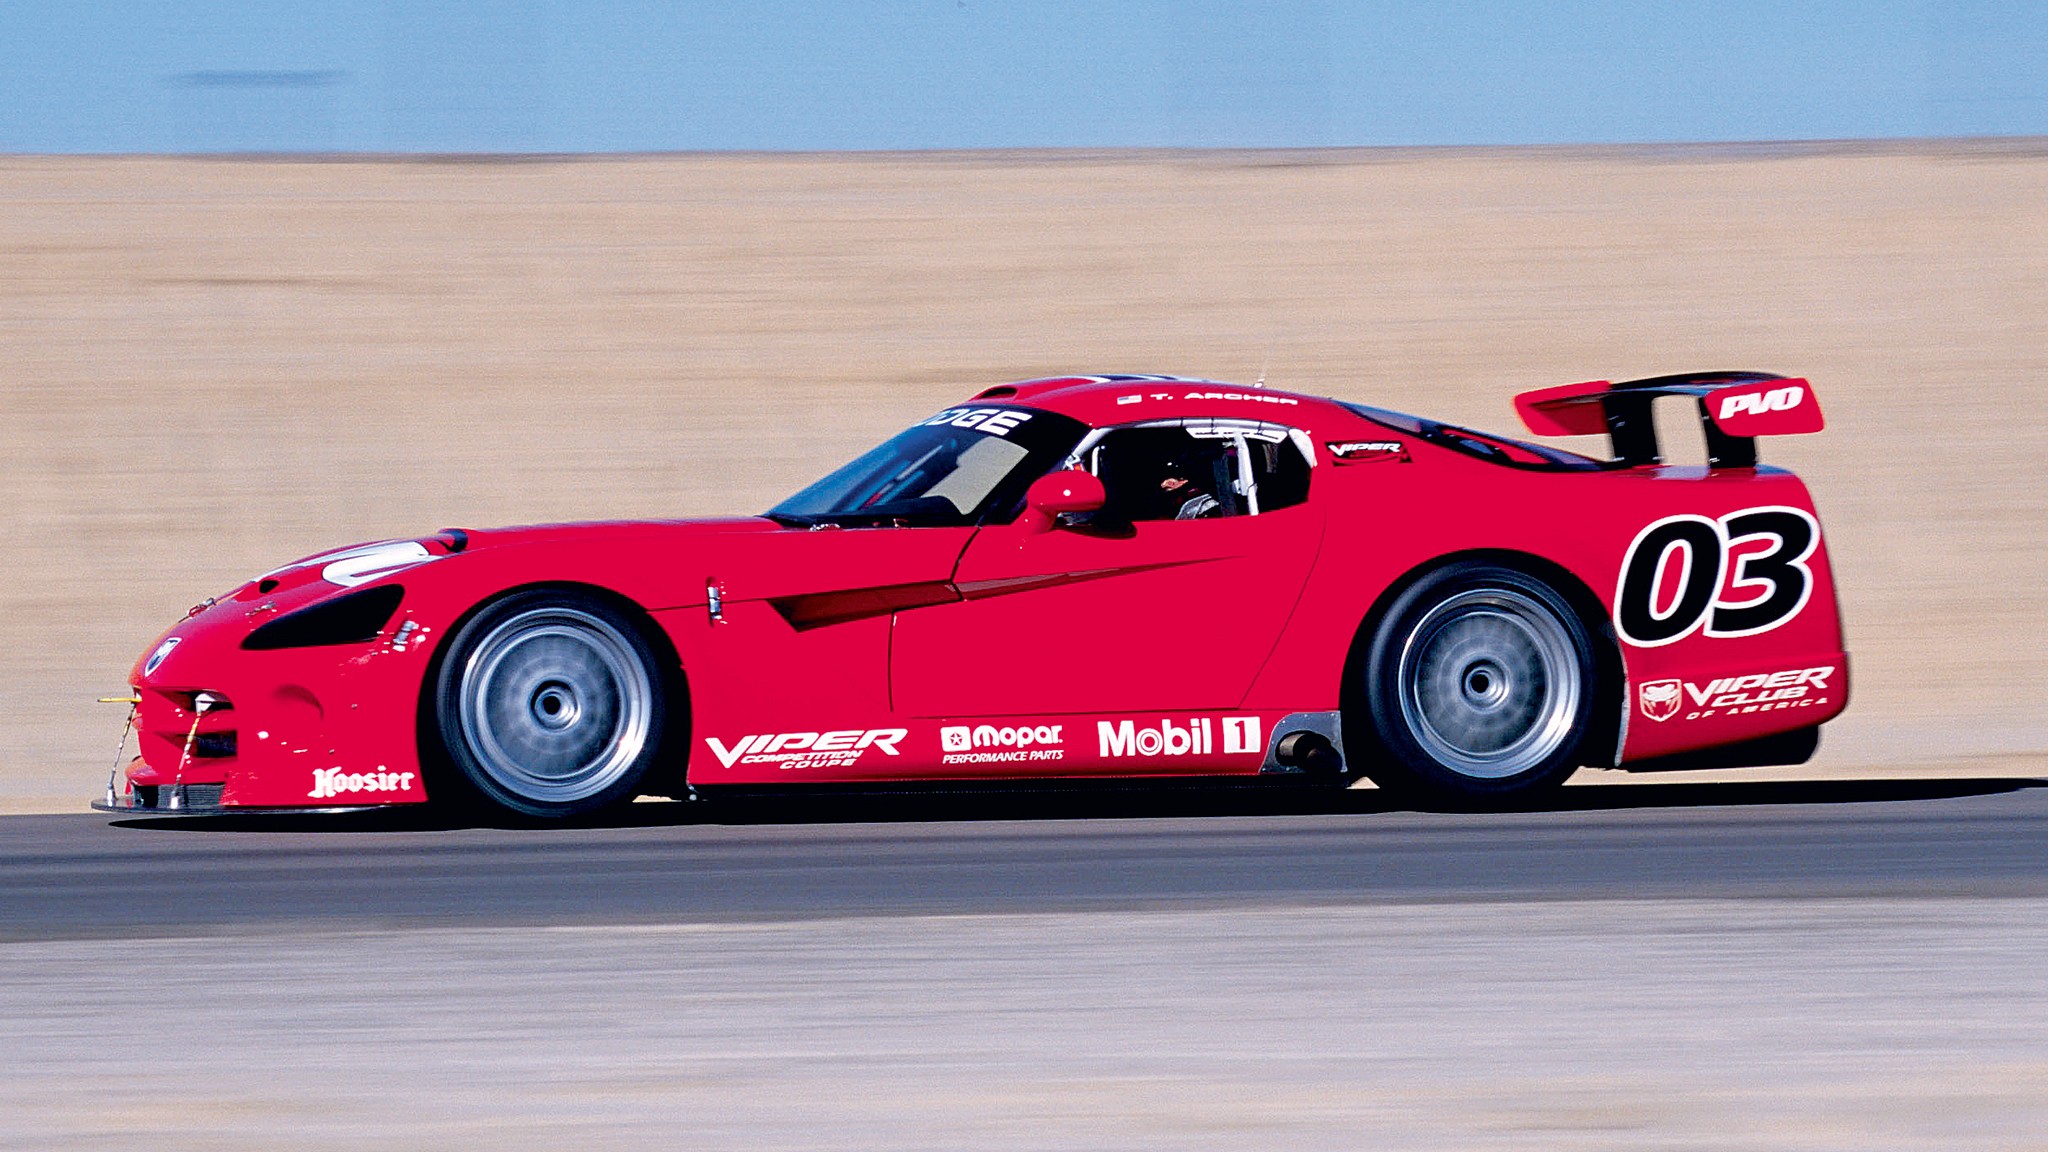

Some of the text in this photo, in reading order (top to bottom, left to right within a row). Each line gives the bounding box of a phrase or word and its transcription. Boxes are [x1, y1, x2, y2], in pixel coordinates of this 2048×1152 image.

[1184, 392, 1298, 405] ARCHER
[1719, 386, 1804, 420] PVO
[911, 408, 1033, 436] DGE
[1328, 443, 1401, 456] VIPER
[1613, 506, 1820, 648] 03
[1683, 666, 1835, 707] VIPER
[1711, 686, 1809, 707] CLUB
[1686, 697, 1828, 720] OF AMERICA
[705, 728, 908, 769] VIPER
[1097, 717, 1212, 758] Mobil
[740, 750, 863, 764] COMPETITION
[779, 758, 857, 769] COUPE
[942, 750, 1064, 764] PERFORMANCE PARTS
[307, 765, 415, 798] Hoosier
